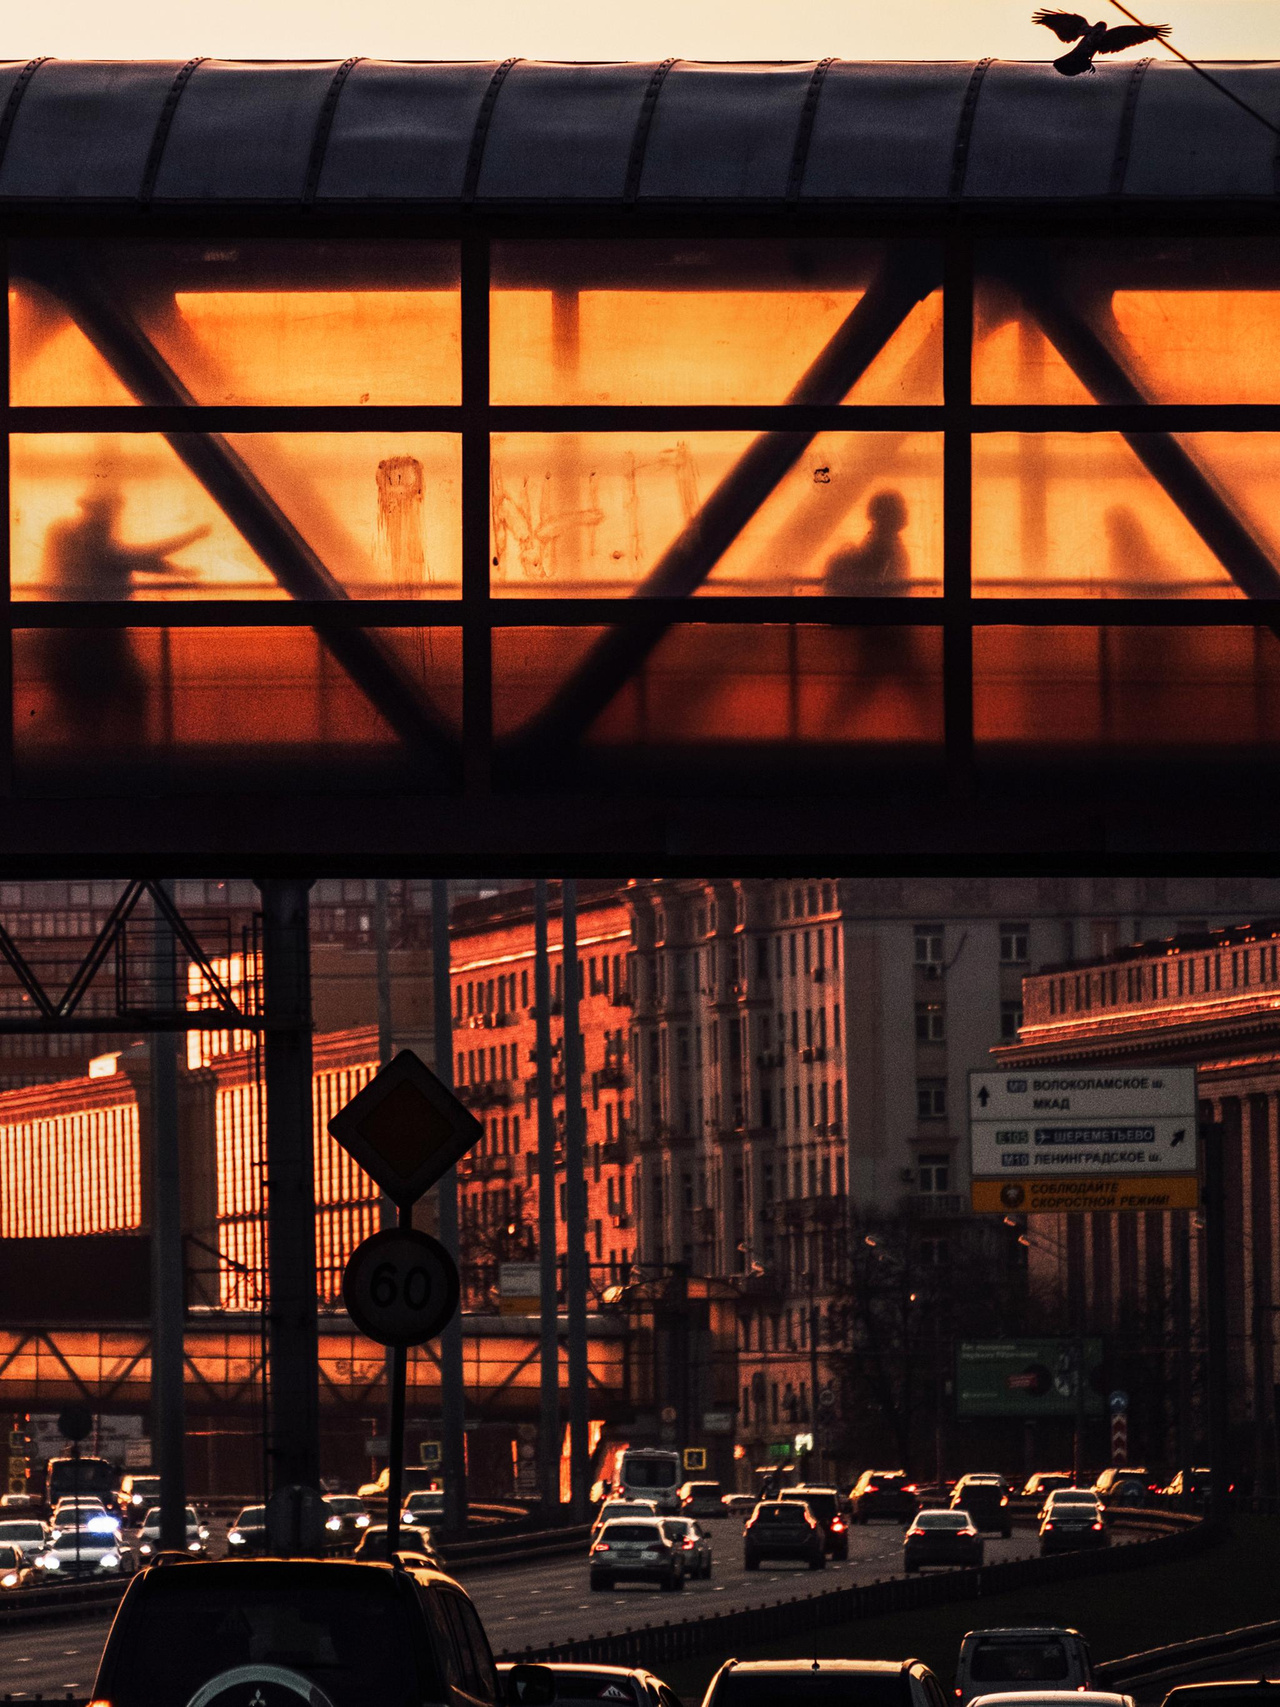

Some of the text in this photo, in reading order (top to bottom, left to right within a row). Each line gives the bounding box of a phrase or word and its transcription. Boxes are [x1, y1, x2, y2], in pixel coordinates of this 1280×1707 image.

[1033, 1078, 1149, 1091] ВОЛОКОЛАМСКОЕ
[1033, 1099, 1071, 1110] МКАД
[1054, 1129, 1154, 1141] ШЕРЕМЕТЬЕВО
[1034, 1153, 1145, 1165] ЛЕНИНГРАДСКОЕ
[1031, 1182, 1119, 1195] СОБЛЮДАЙТЕ
[1031, 1195, 1170, 1208] СКОРОСТНОЙ РЕЖИМ!
[370, 1262, 431, 1310] 60
